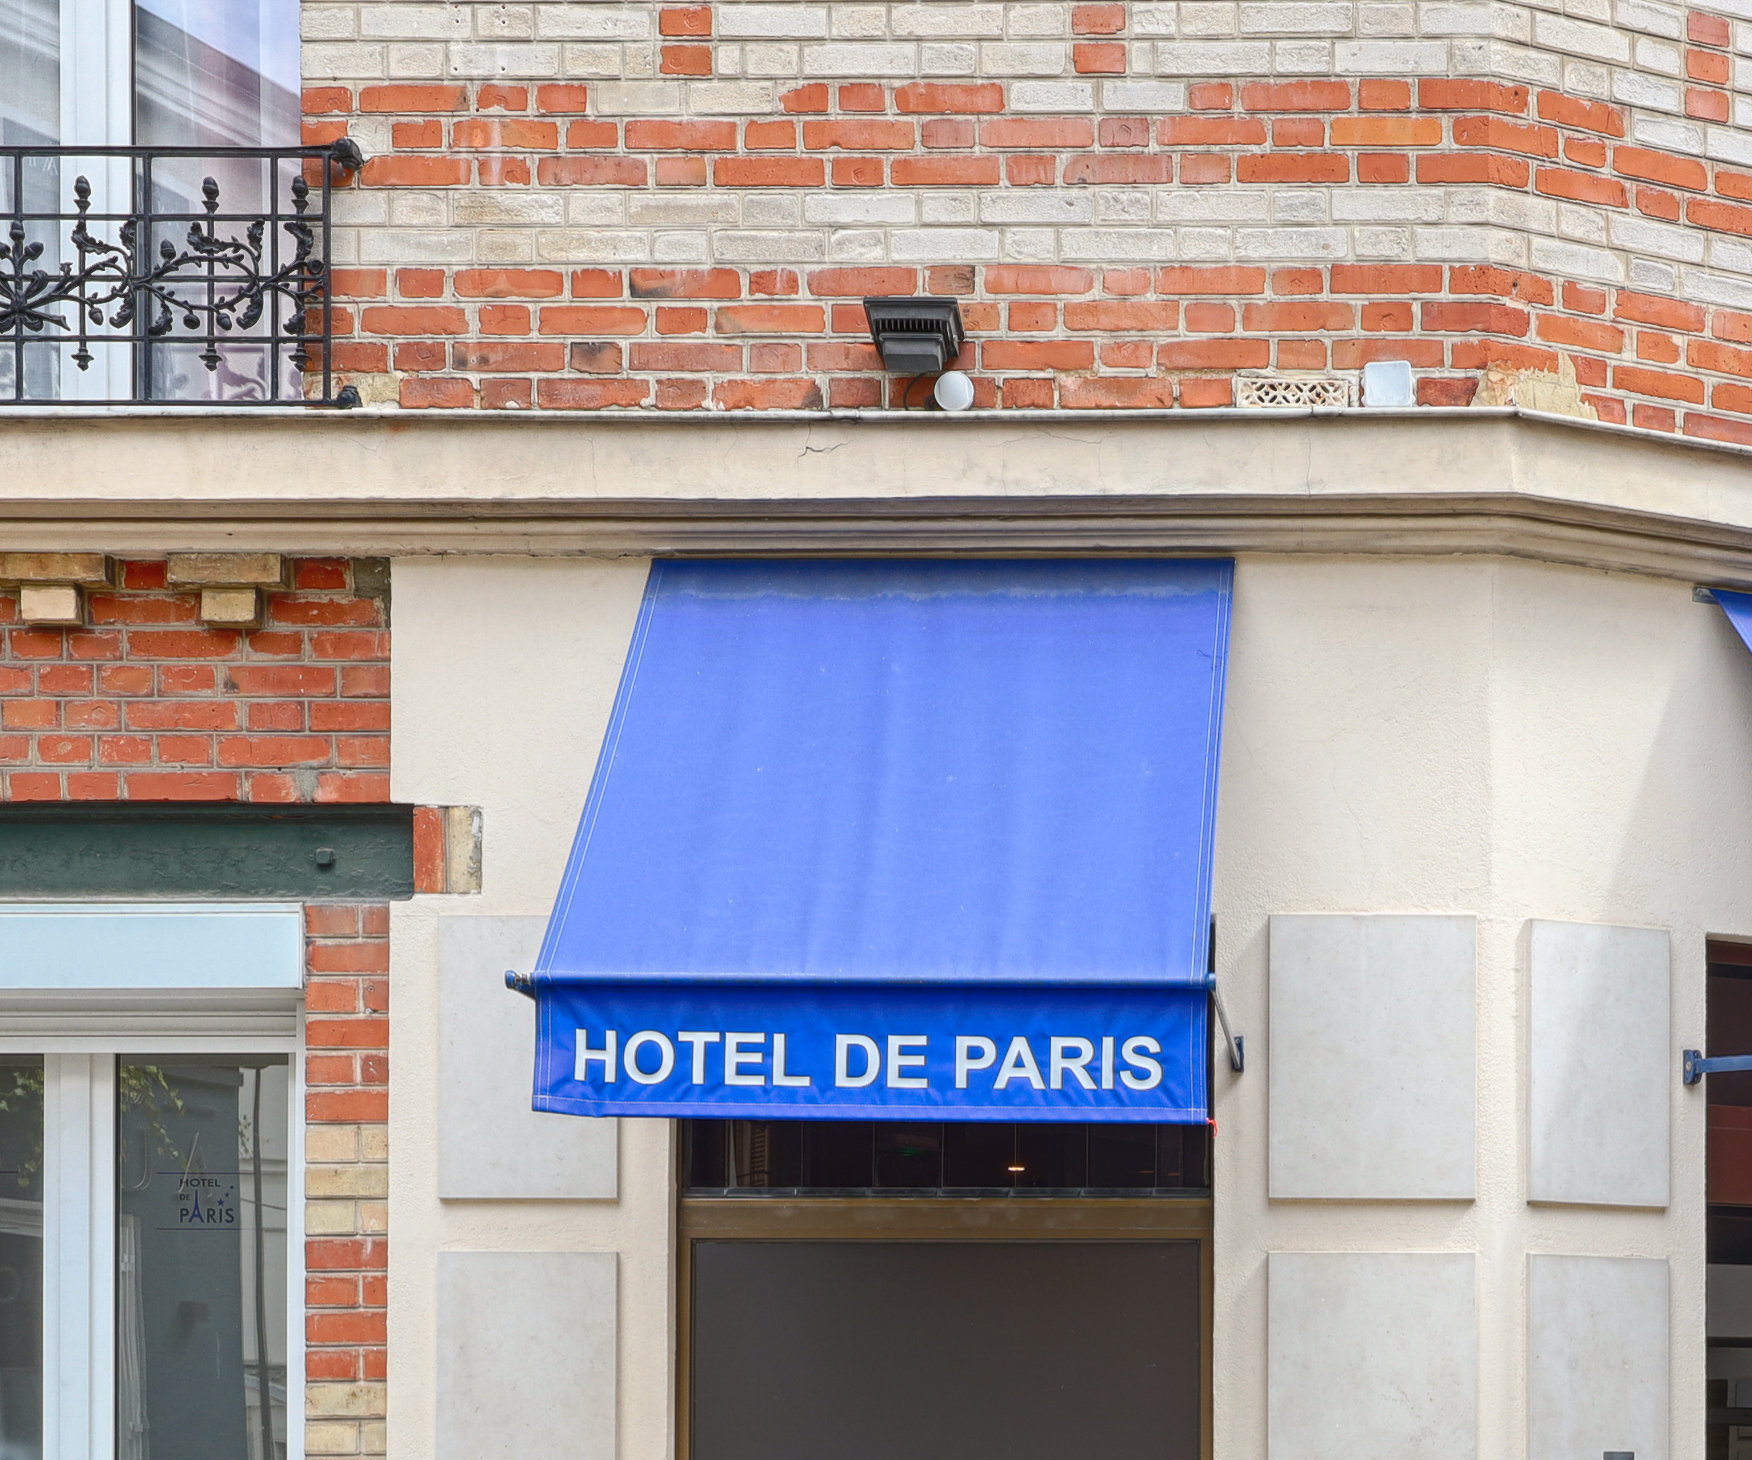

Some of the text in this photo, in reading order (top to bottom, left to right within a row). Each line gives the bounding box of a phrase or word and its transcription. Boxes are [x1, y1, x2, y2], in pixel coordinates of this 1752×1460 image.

[573, 1028, 1163, 1091] HOTEL DE PARIS
[179, 1178, 221, 1188] HOTEL
[179, 1200, 235, 1224] PARIS
